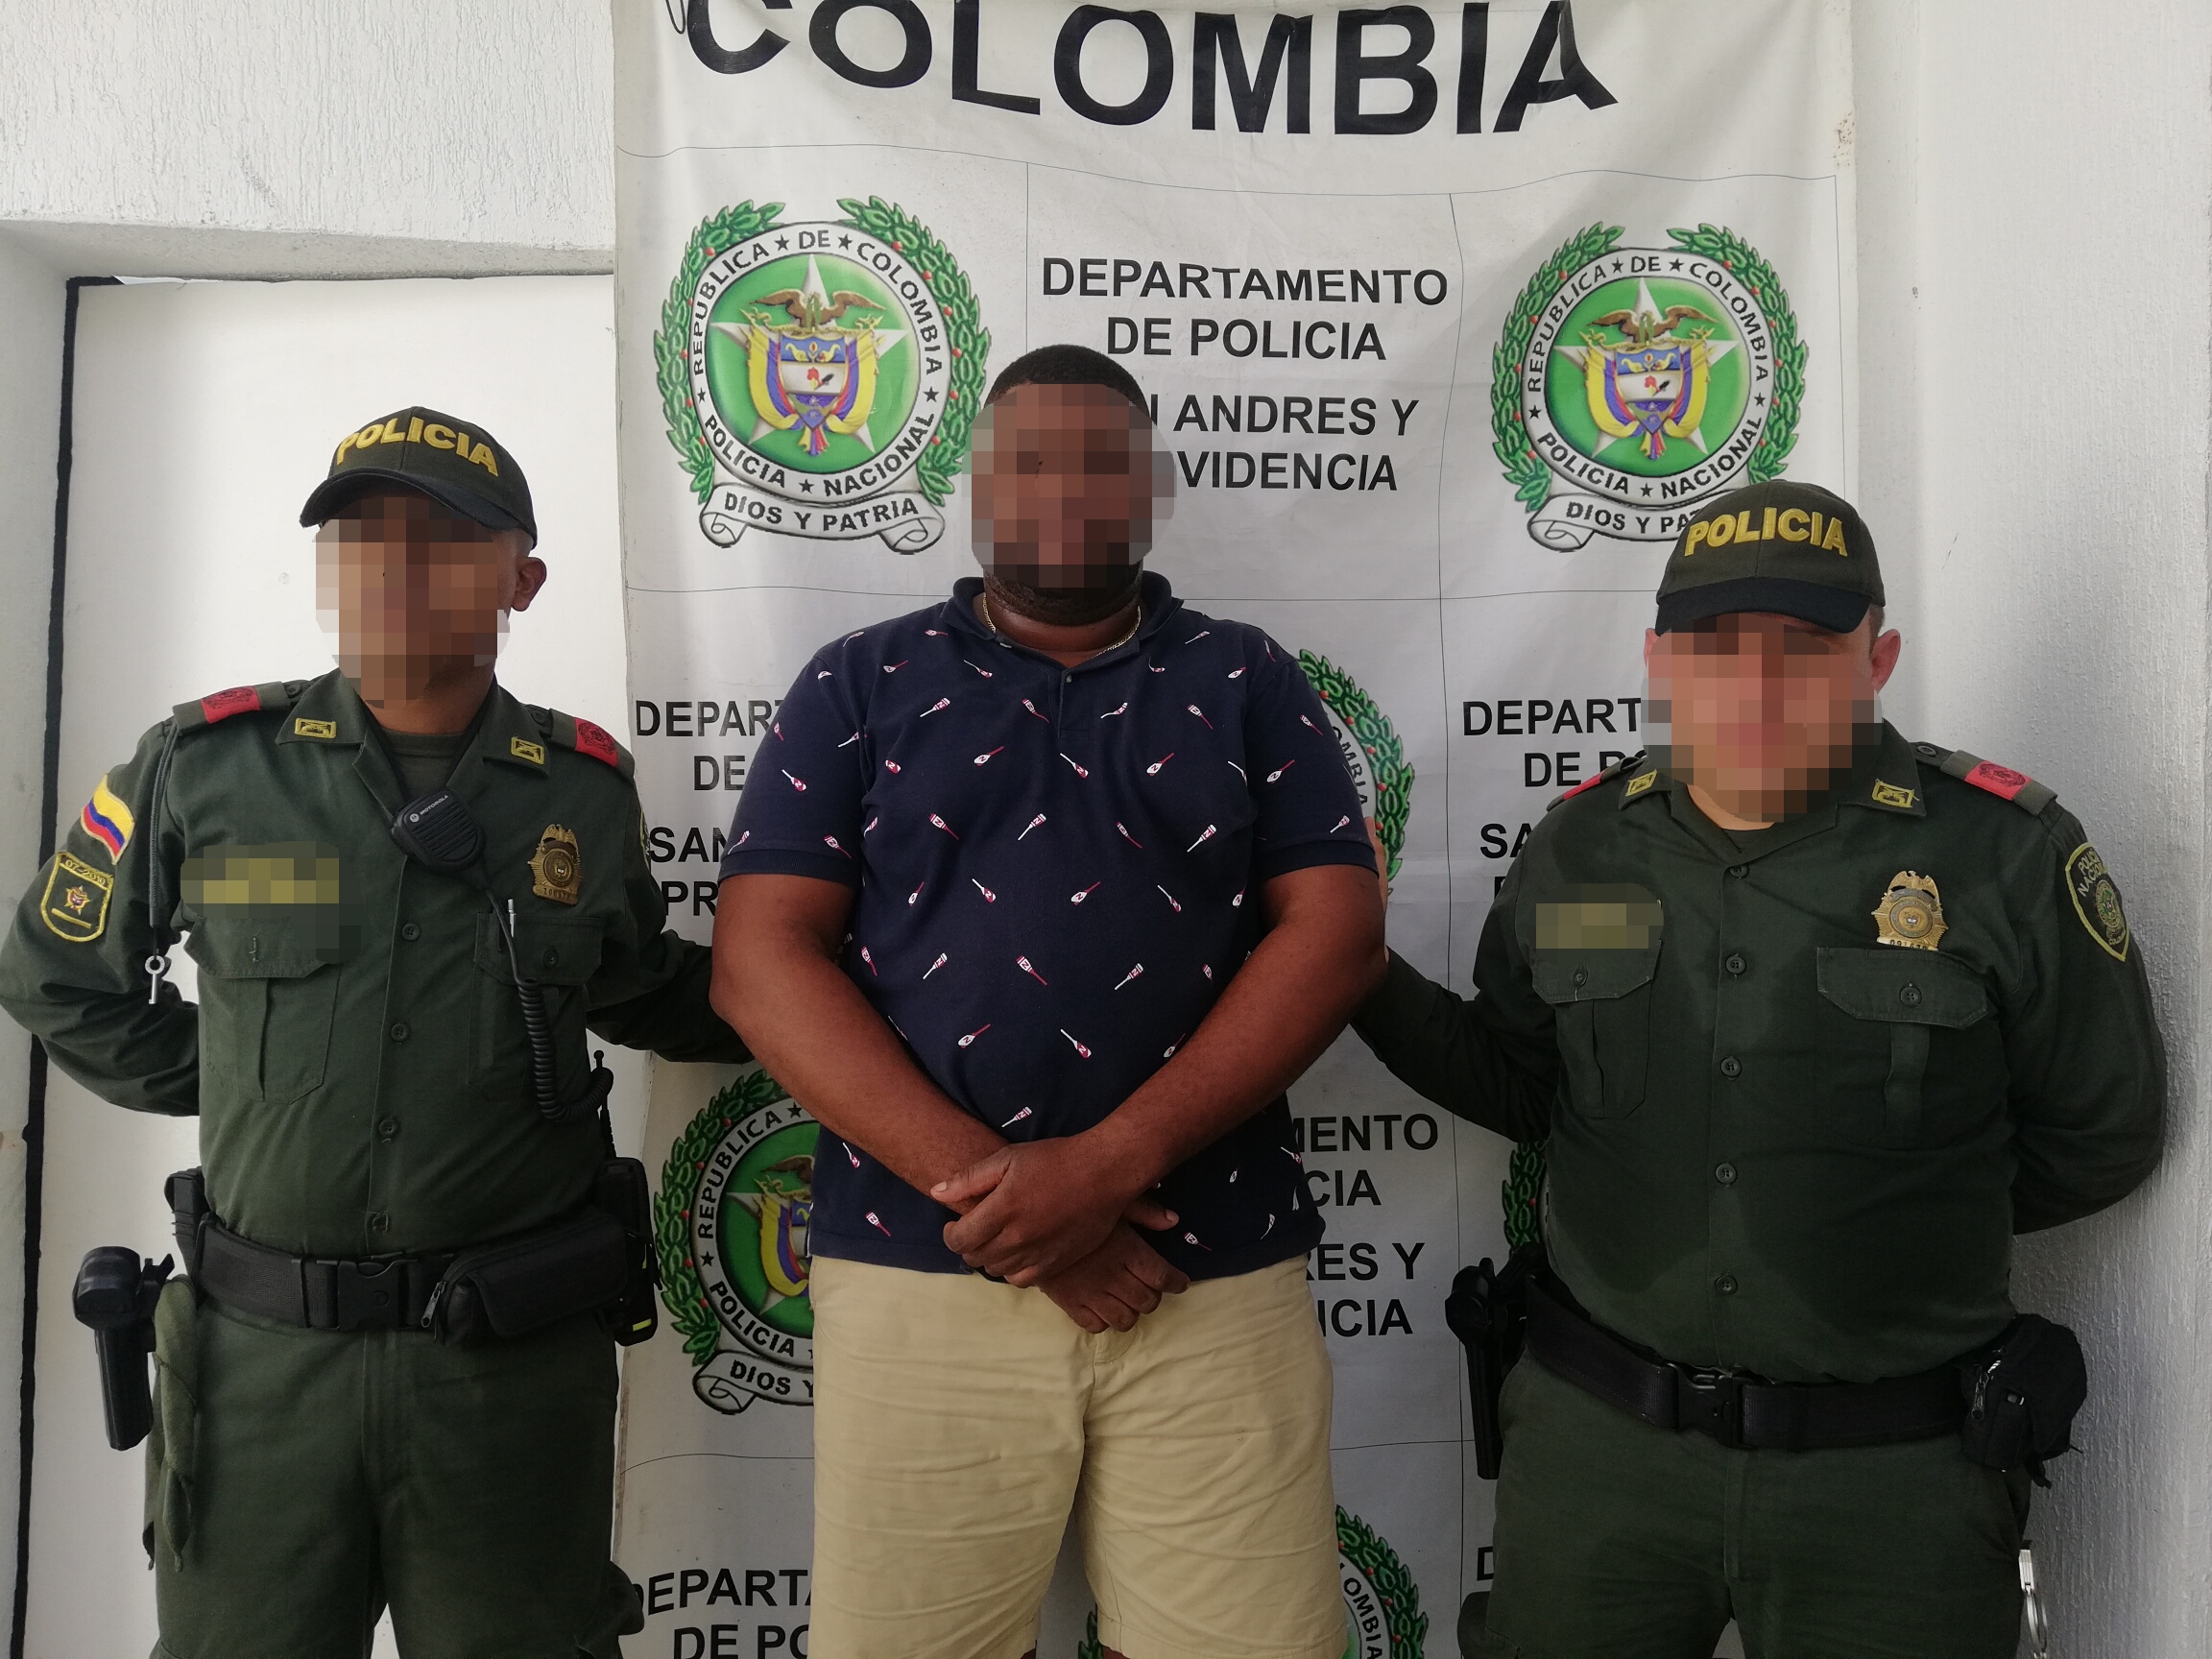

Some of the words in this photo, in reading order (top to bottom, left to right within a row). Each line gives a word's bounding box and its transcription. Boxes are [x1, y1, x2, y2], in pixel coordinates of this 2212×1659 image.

[686, 0, 1619, 135] COLOMBIA
[693, 242, 770, 375] REPUBLICA
[798, 229, 831, 250] DE
[856, 241, 943, 374] COLOMBIA
[1043, 257, 1448, 305] DEPARTAMENTO
[1107, 316, 1172, 356] DE
[1190, 318, 1387, 361] POLICIA
[1527, 264, 1607, 393] REPUBLICA
[1631, 255, 1662, 273] DE
[1689, 262, 1768, 382] COLOMBIA
[1173, 394, 1377, 436] ANDRES
[1390, 398, 1420, 436] Y
[336, 416, 499, 477] POLICIA
[705, 414, 785, 489] POLICIA
[823, 412, 936, 497] NACIONAL
[1537, 431, 1629, 495] POLICIA
[1660, 417, 1763, 499] NACIONAL
[1176, 450, 1398, 492] VIDENCIA
[724, 491, 783, 524] DIOS
[793, 511, 812, 531] Y
[822, 496, 920, 532] PATRIA
[1566, 500, 1625, 531] DIOS
[1635, 516, 1651, 534] Y
[1660, 510, 1701, 534] PA
[1684, 506, 1848, 557] POLICIA
[635, 699, 784, 737] DEPAR
[693, 755, 746, 791] DE
[1524, 751, 1582, 787] DE
[419, 794, 449, 816] MOTOROLA
[698, 1109, 782, 1239] REPUBLICA
[1391, 1241, 1426, 1281] Y
[709, 1280, 795, 1358] POLICIA
[730, 1359, 791, 1396] DIOS
[631, 1568, 812, 1616] EPART
[1339, 1563, 1383, 1659] OMBIA
[673, 1623, 739, 1659] DE
